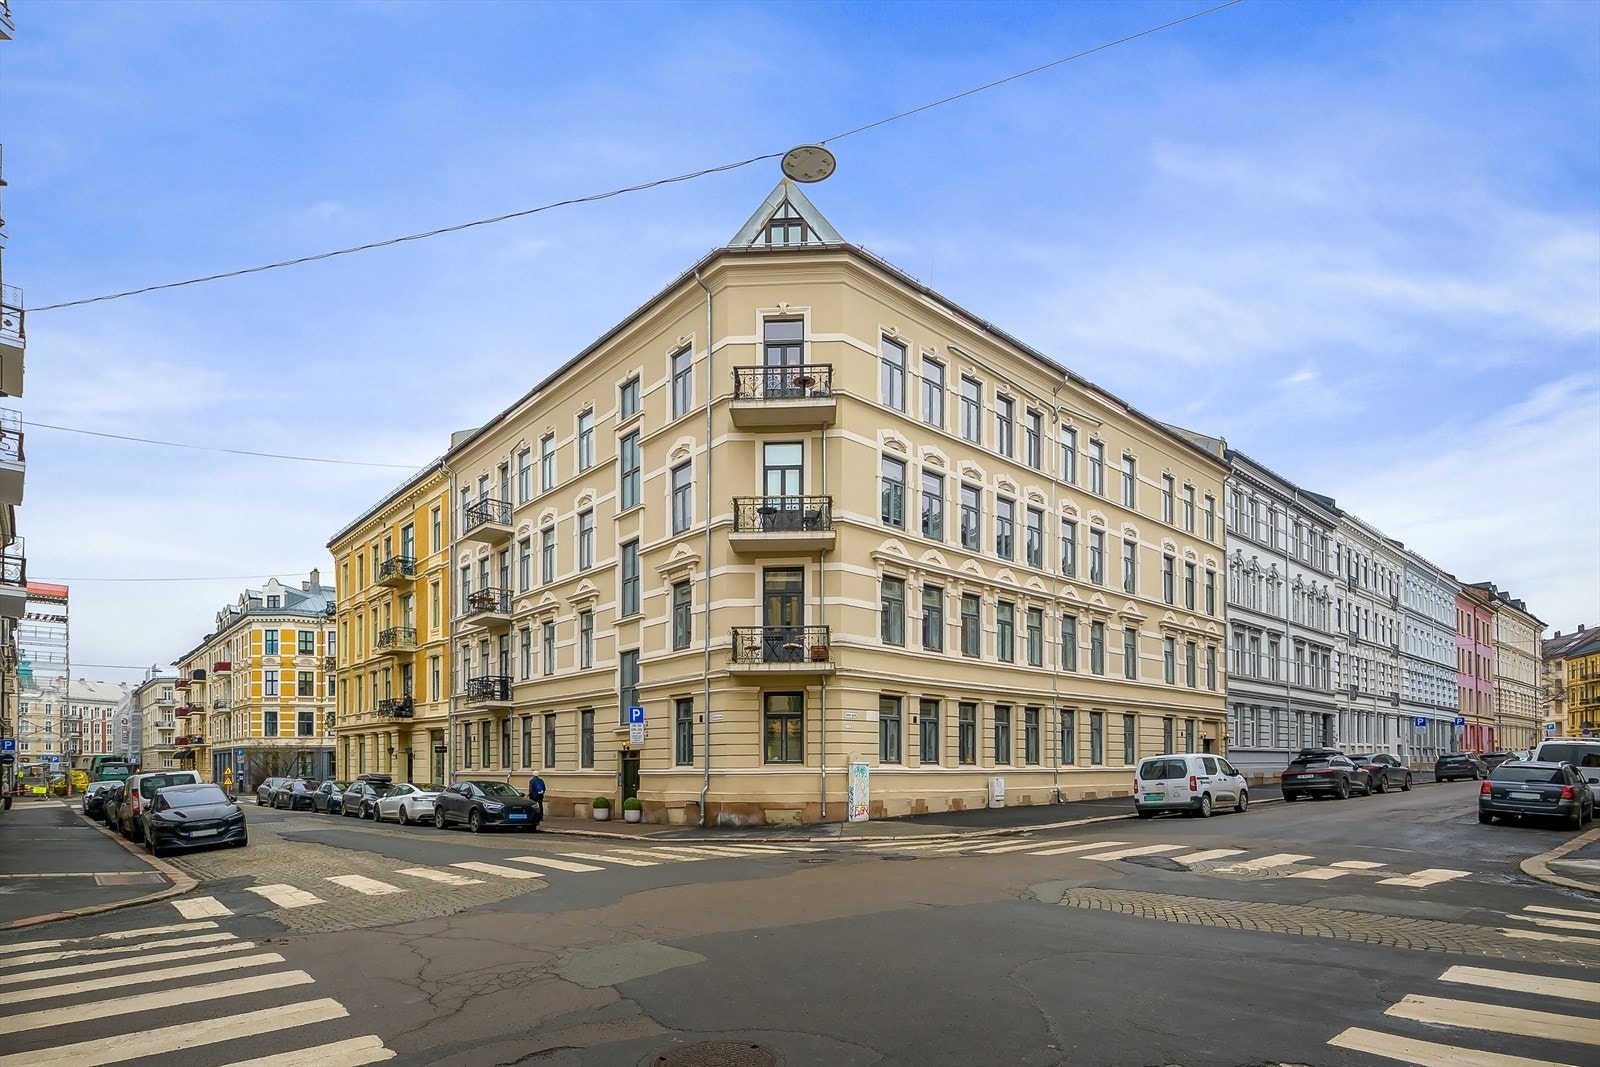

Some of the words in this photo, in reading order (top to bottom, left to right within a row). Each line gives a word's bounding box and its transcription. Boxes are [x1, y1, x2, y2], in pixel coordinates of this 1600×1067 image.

[632, 708, 641, 722] P
[1417, 718, 1424, 726] P
[4, 740, 13, 750] P
